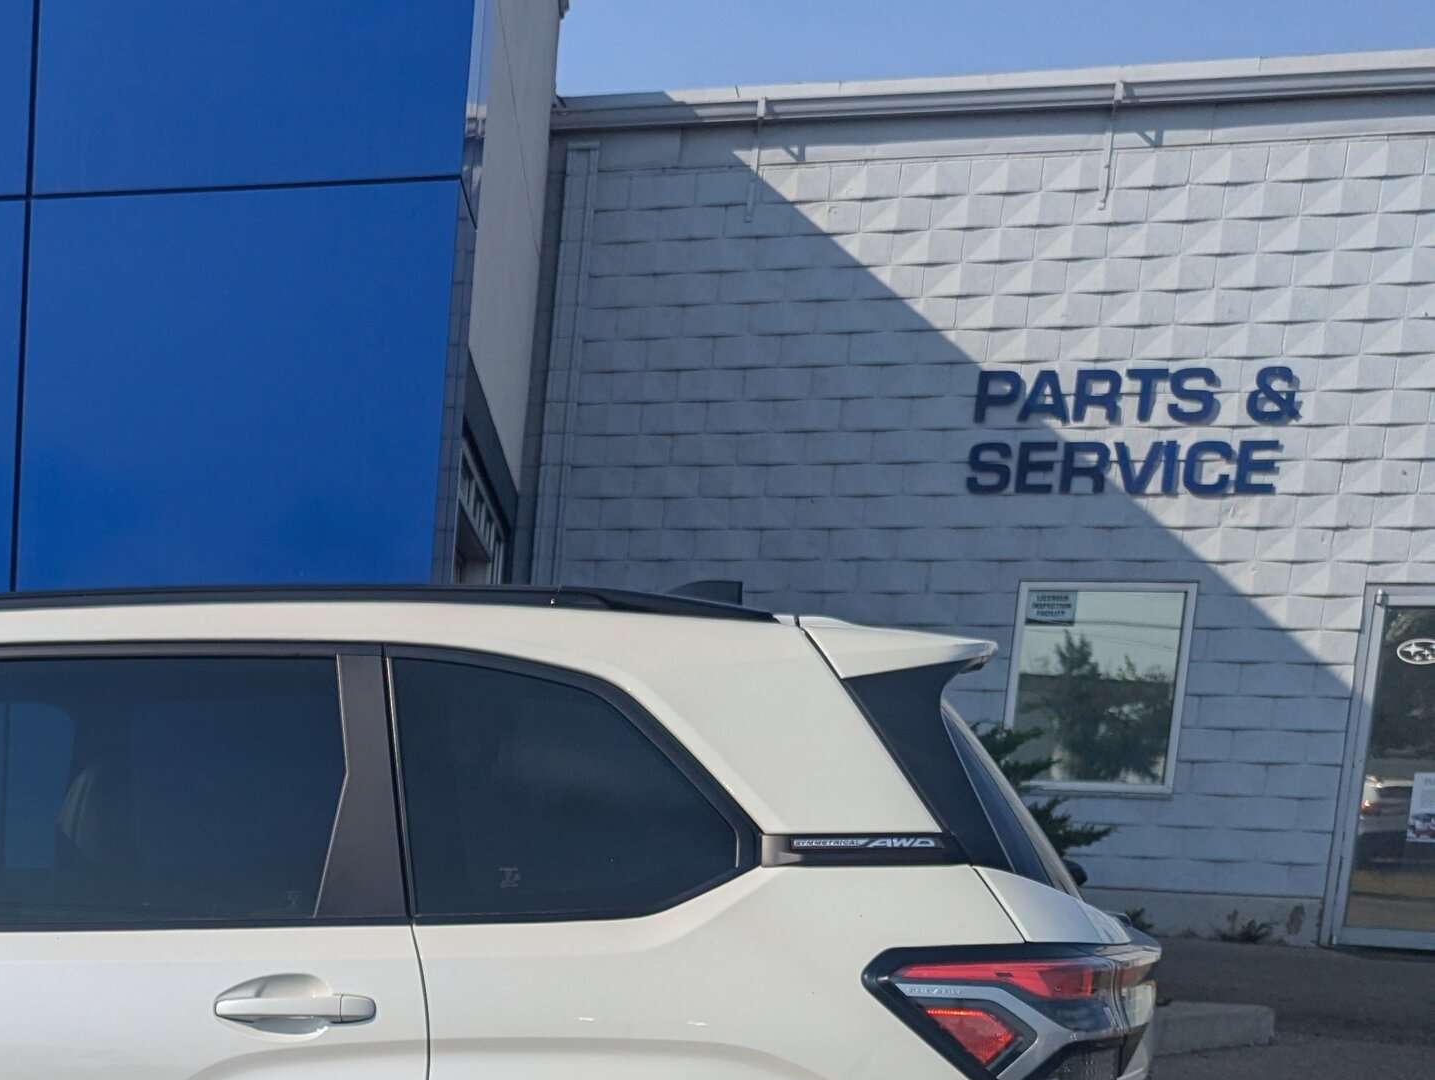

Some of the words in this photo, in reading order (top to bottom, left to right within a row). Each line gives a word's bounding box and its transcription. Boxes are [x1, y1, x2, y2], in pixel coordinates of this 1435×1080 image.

[972, 366, 1219, 424] PARTS
[1246, 366, 1302, 422] &
[966, 439, 1282, 496] SERVICE
[866, 838, 936, 848] AWD
